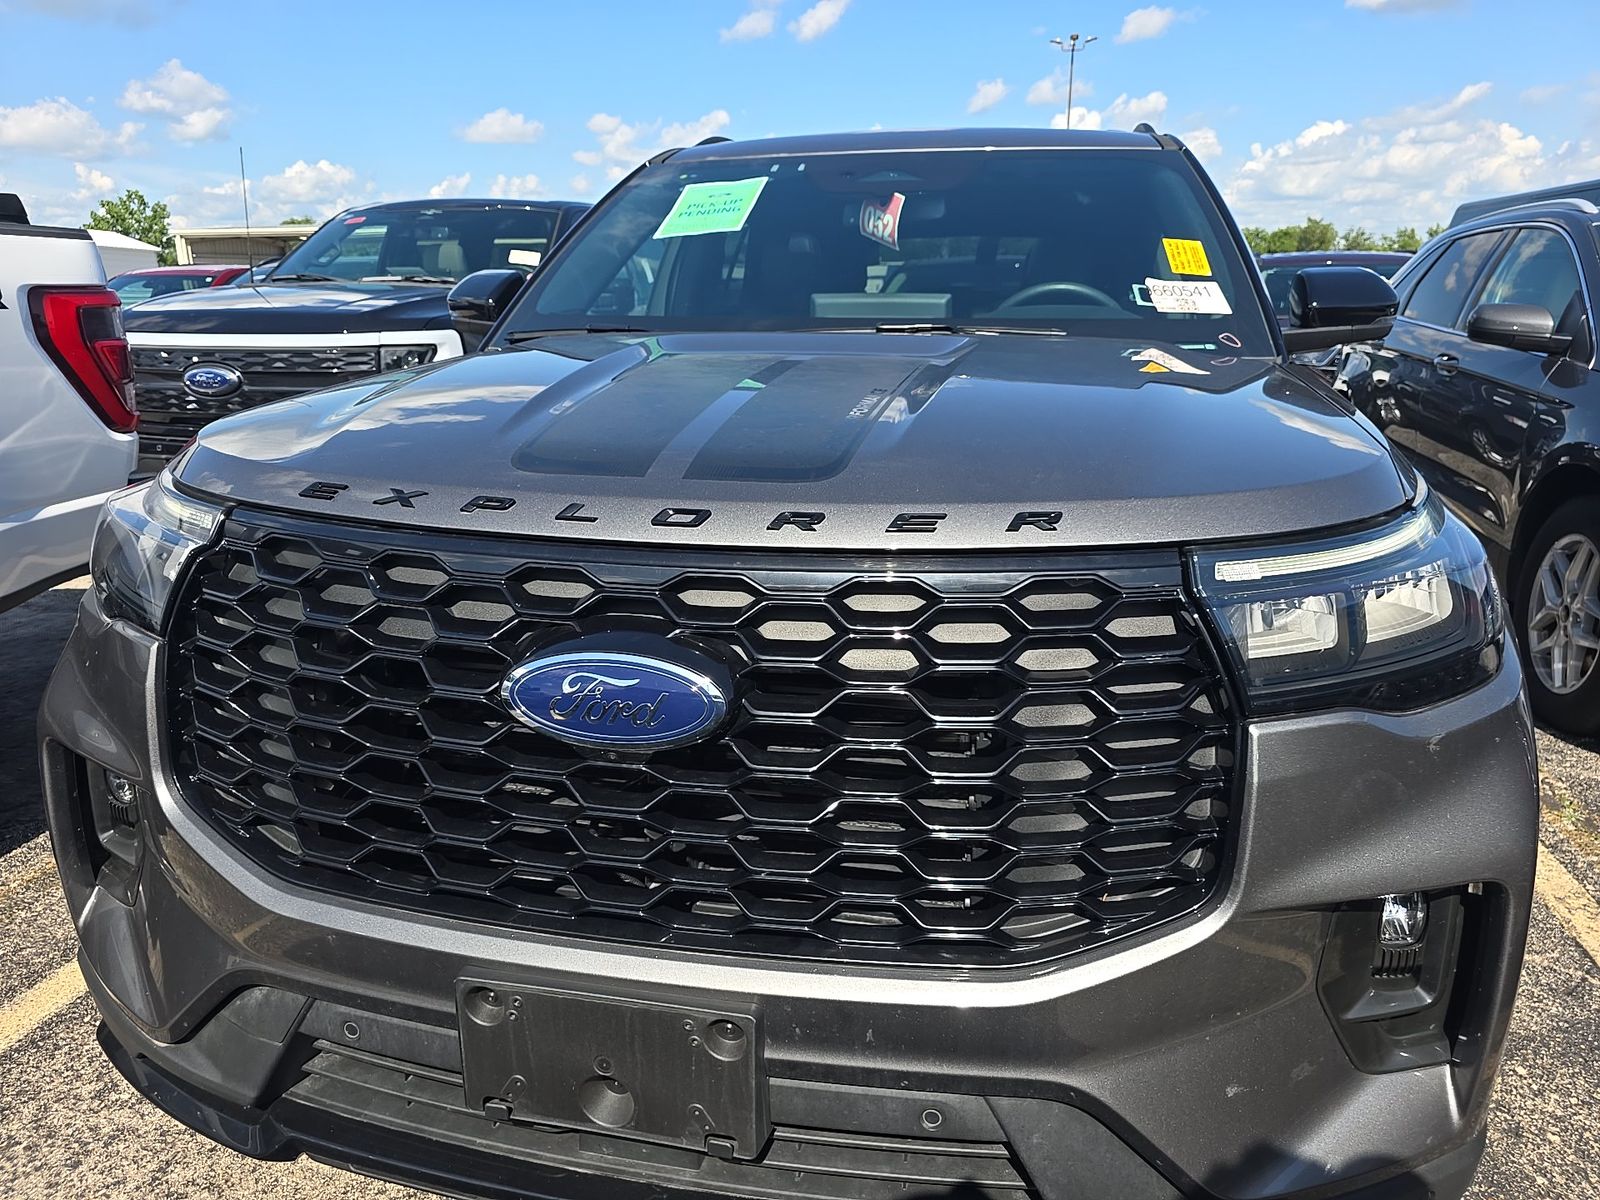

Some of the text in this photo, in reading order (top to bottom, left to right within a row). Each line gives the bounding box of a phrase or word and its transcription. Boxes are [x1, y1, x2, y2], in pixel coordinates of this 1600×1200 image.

[678, 206, 742, 218] PENDING
[298, 481, 1063, 534] EXPLORER
[550, 672, 669, 729] Ford
